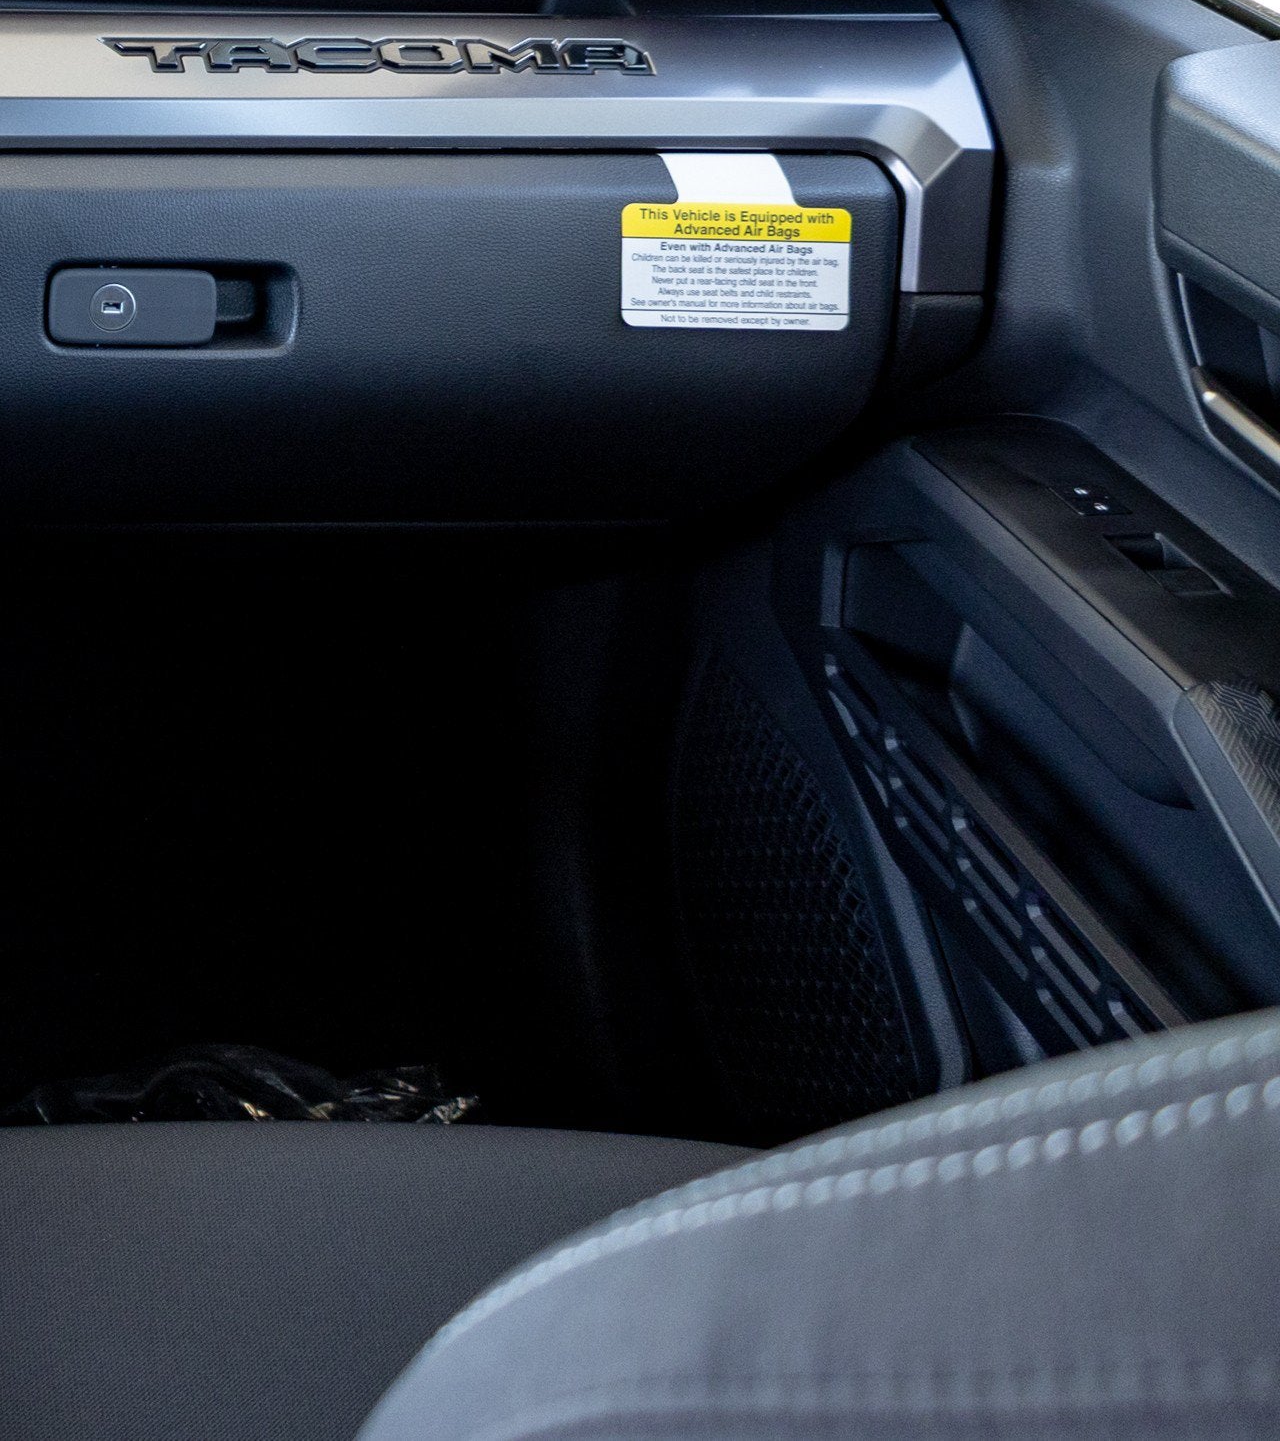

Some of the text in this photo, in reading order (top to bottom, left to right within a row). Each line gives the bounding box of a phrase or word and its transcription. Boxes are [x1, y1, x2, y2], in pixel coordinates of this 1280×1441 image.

[97, 36, 657, 76] TACOMA
[640, 208, 834, 225] This Vehicle is Equipped with
[674, 223, 800, 240] Advanced Air Bags
[660, 242, 813, 256] Even with Advanced Air Bags
[632, 253, 663, 262] Children
[681, 254, 690, 262] be
[693, 254, 712, 263] killed
[724, 255, 757, 266] seriously
[760, 257, 785, 266] injured
[786, 257, 795, 267] by
[798, 257, 809, 265] the
[812, 258, 821, 266] air
[823, 258, 839, 268] bag.
[660, 314, 676, 322] Not
[688, 315, 699, 323] be
[701, 315, 738, 324] removed
[741, 317, 768, 325] except
[771, 317, 780, 326] by
